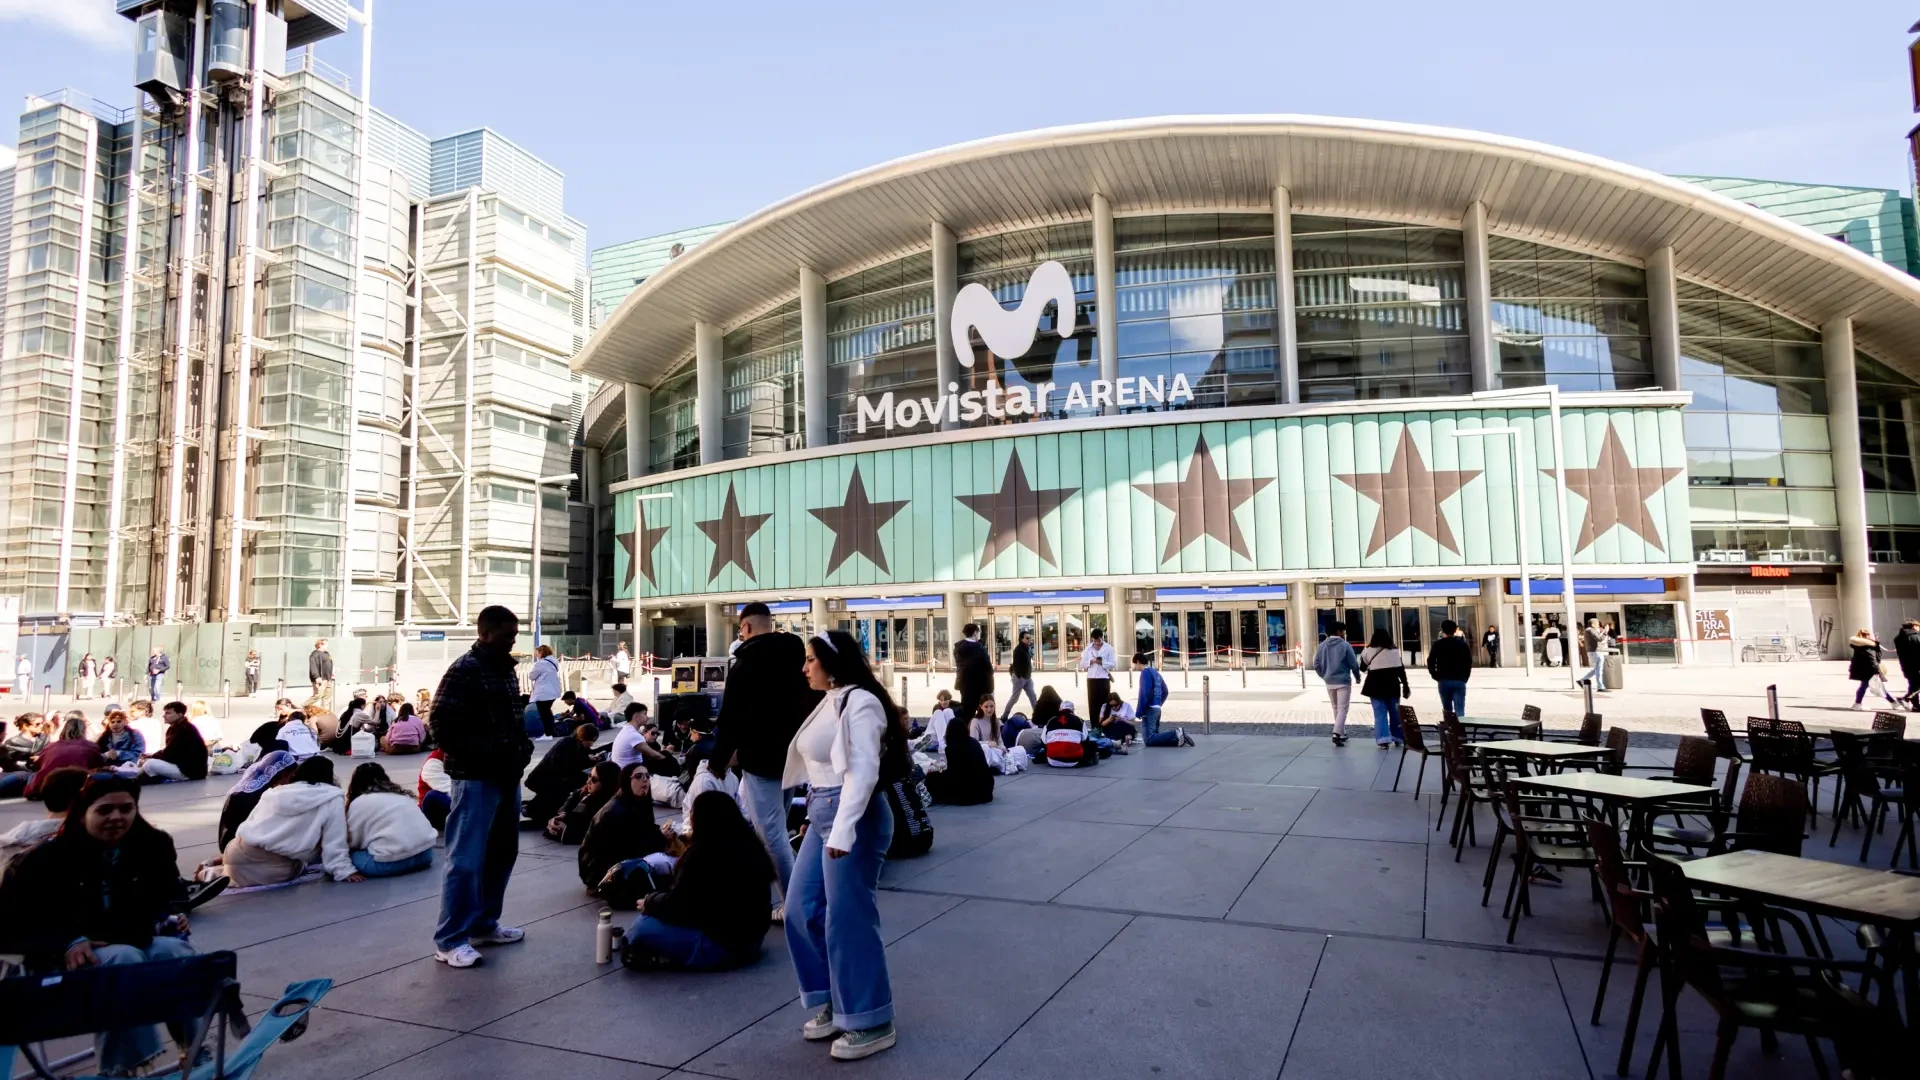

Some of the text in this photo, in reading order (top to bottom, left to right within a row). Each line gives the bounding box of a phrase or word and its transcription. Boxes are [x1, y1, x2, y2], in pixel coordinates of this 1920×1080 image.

[857, 373, 1194, 433] Movistar ARENA
[1751, 566, 1789, 577] Mahou
[1703, 620, 1726, 630] RRA
[1704, 630, 1718, 640] ZA
